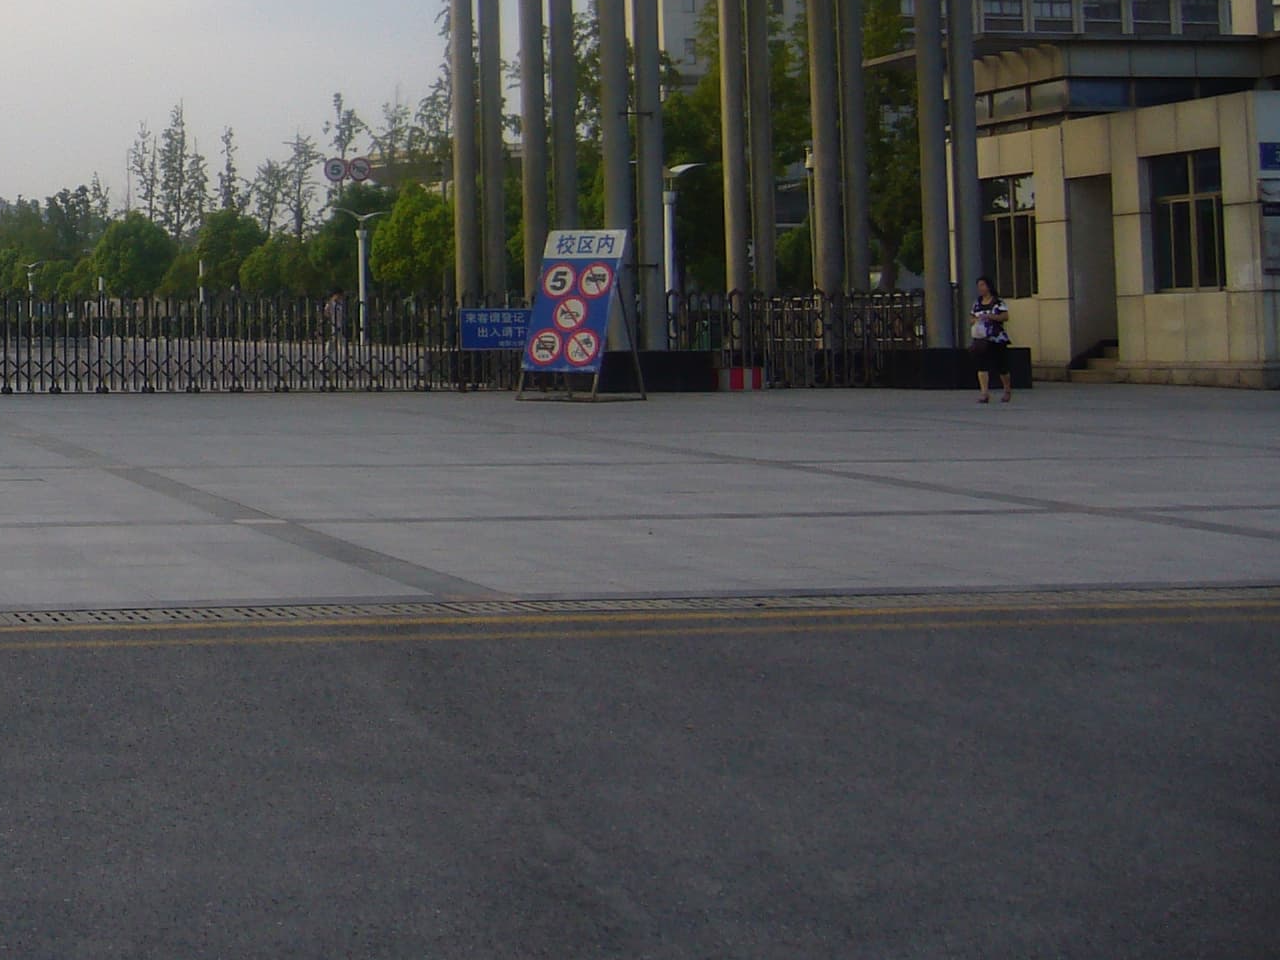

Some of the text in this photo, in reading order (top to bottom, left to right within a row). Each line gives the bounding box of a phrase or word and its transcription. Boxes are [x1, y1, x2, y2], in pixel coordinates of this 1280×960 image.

[331, 164, 341, 175] 5
[556, 234, 615, 254] 校区内
[550, 271, 567, 290] 5
[477, 326, 527, 337] 出入请下
